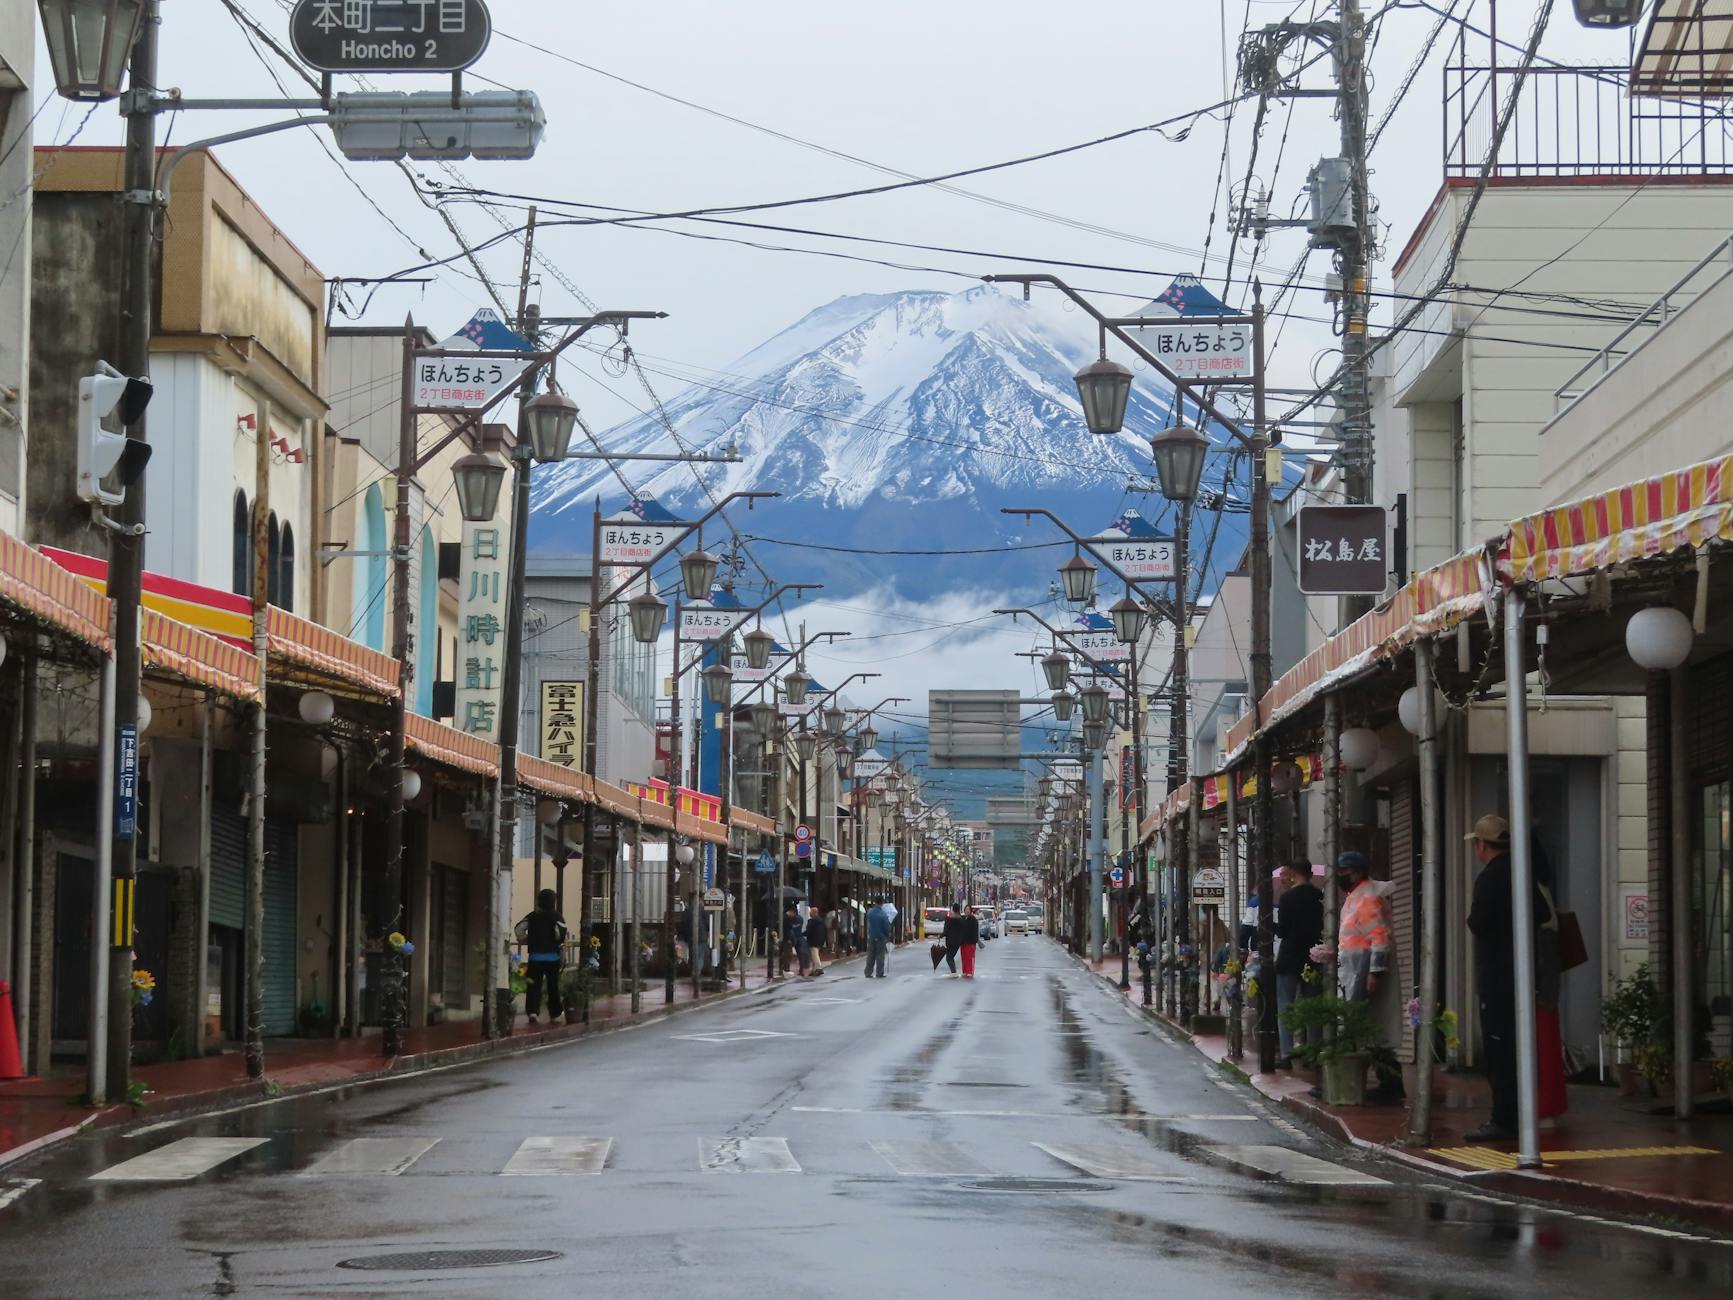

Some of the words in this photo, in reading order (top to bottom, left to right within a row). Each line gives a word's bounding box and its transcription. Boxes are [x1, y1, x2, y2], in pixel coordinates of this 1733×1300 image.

[312, 0, 466, 34] 本町二丁目
[341, 40, 416, 58] Honcho
[424, 40, 437, 58] 2
[1157, 331, 1245, 353] ほんちょう
[1175, 356, 1245, 371] 2丁目商店街
[421, 364, 502, 384] ほんちょう
[420, 388, 486, 400] 2丁目商店街
[605, 530, 664, 546] ほんちょう
[1112, 546, 1169, 561] ほんちょう
[1304, 537, 1382, 562] 松島屋
[684, 615, 731, 627] ほんちょう
[463, 527, 499, 733] 日川時計店
[733, 659, 774, 669] ほんう
[124, 800, 130, 813] 1
